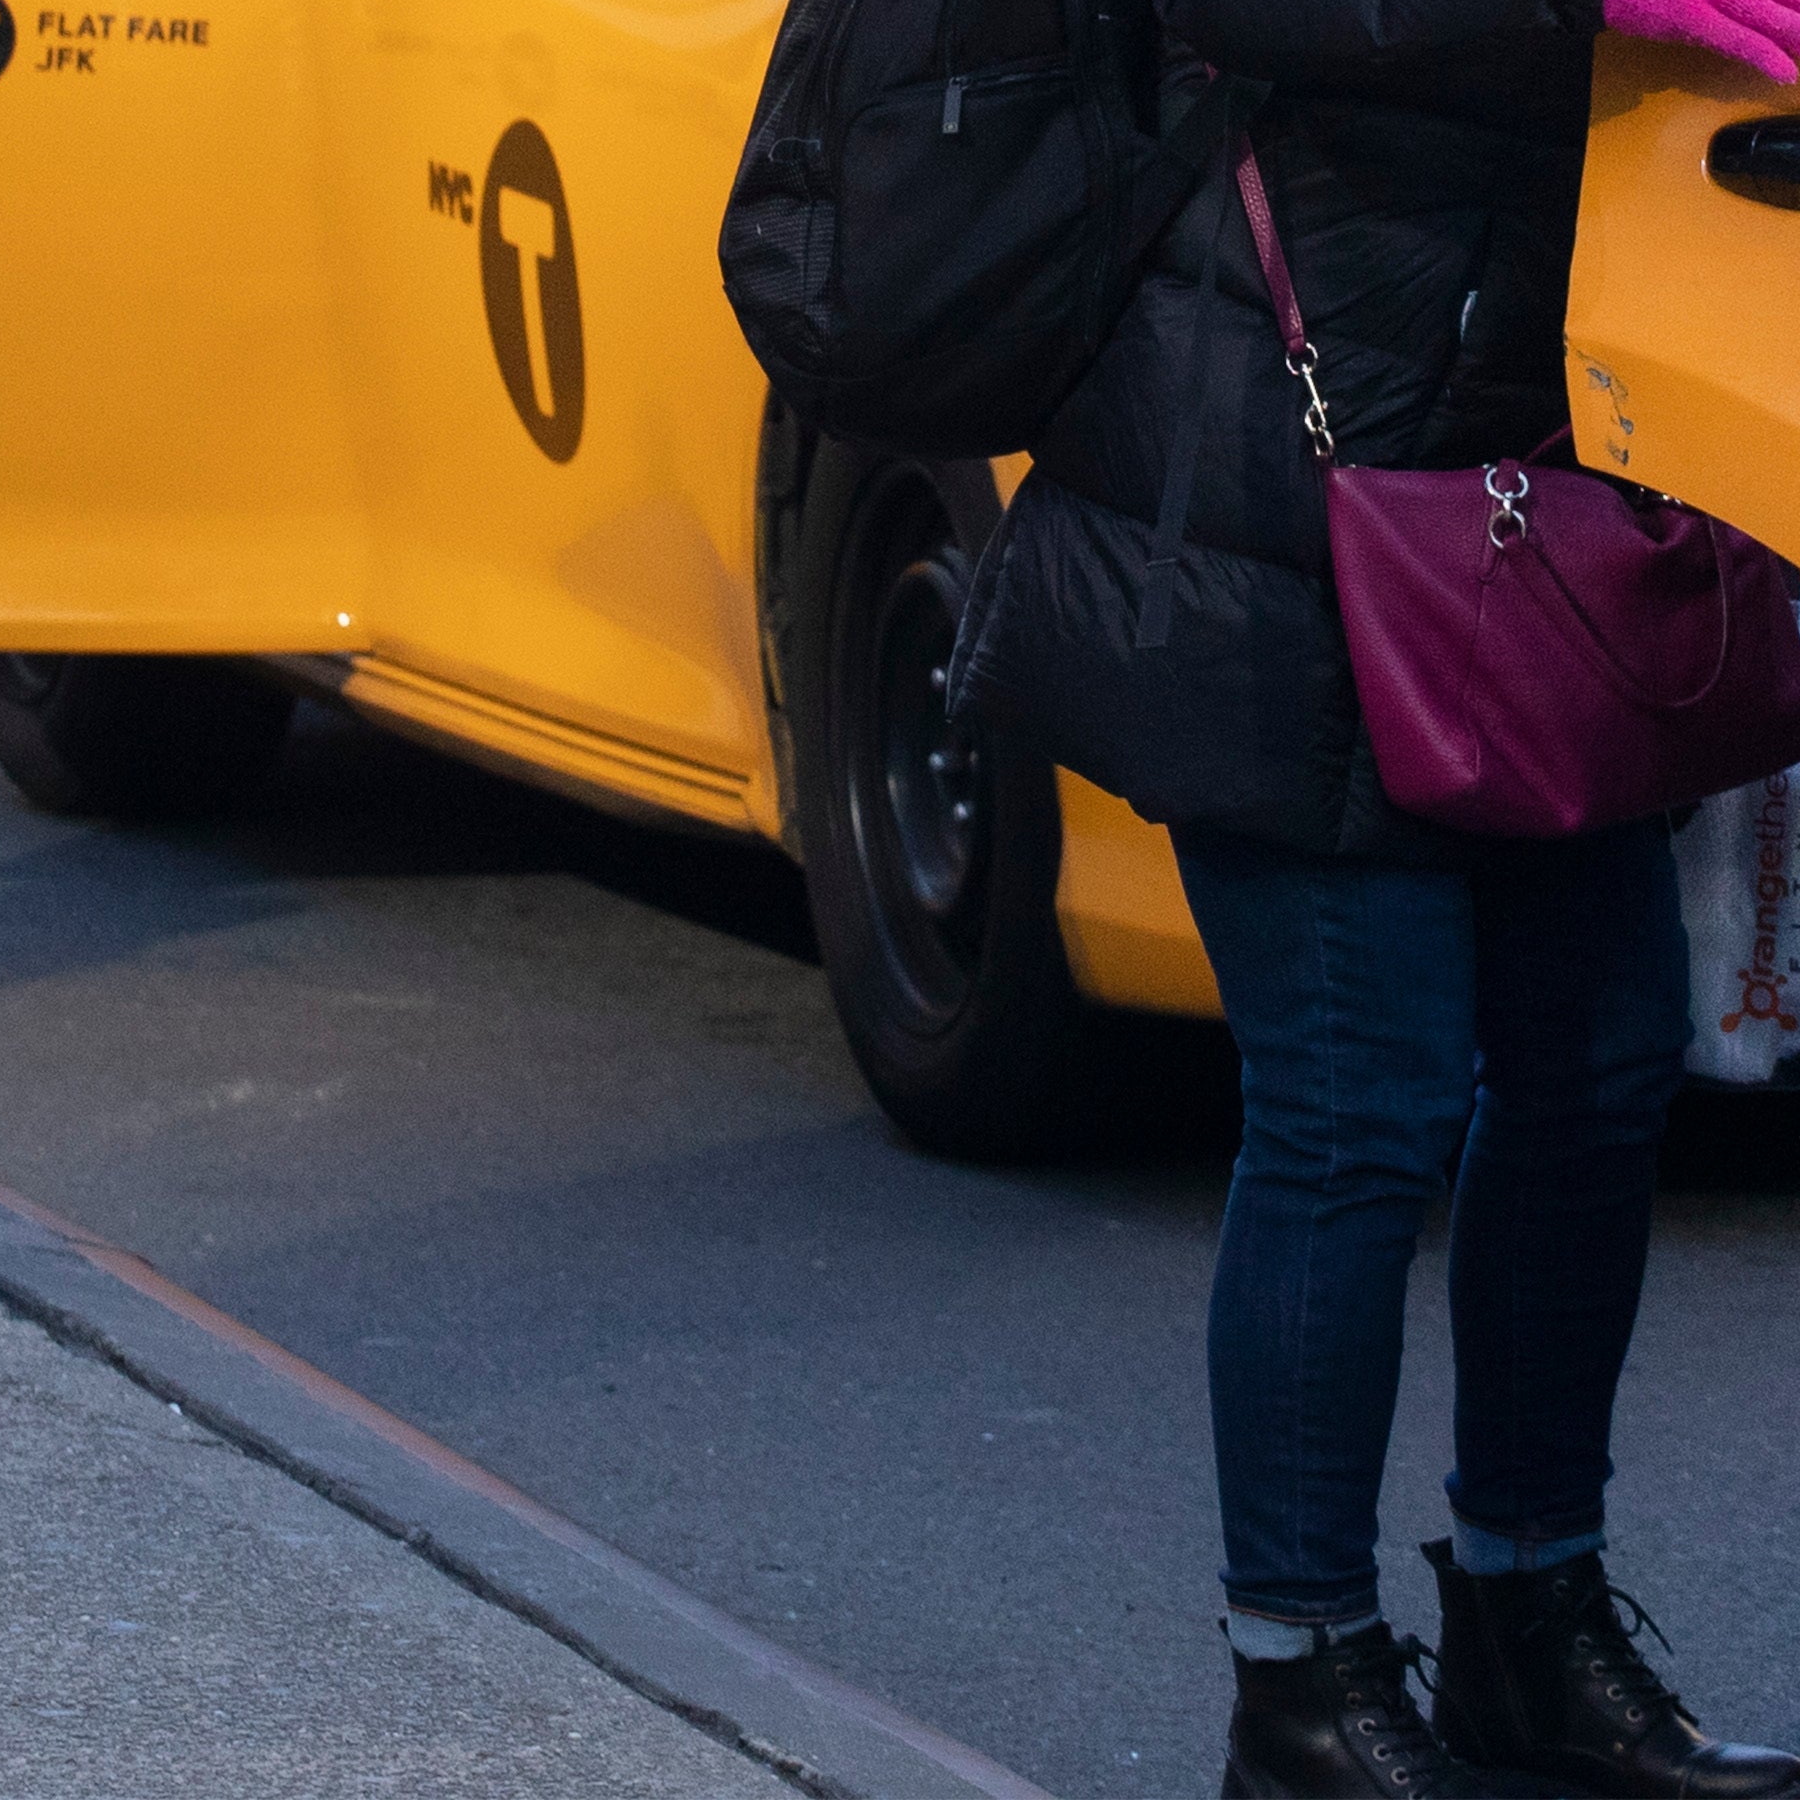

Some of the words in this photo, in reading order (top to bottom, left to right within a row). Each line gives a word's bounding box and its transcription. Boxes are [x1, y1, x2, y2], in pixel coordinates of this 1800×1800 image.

[38, 11, 115, 40] FLAT
[127, 16, 209, 47] FARE
[34, 46, 96, 75] JFK
[427, 158, 474, 227] NYC
